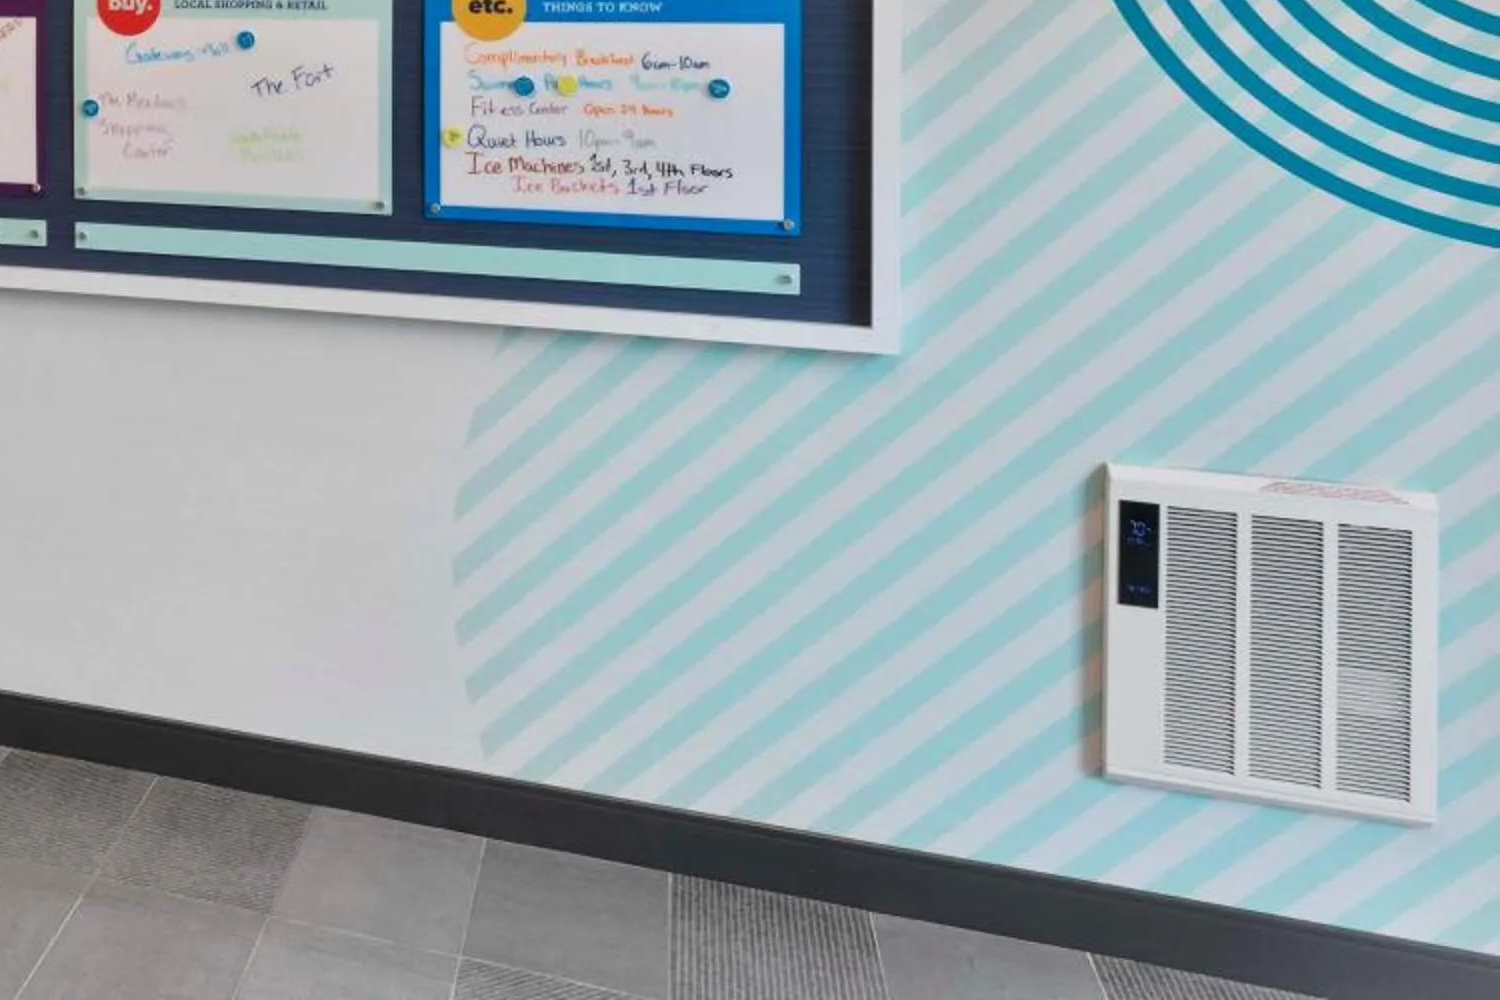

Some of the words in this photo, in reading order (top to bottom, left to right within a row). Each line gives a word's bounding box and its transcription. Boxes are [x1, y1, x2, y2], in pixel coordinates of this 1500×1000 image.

[173, 0, 212, 10] LOCAL
[214, 0, 274, 10] SHOPPING
[275, 0, 284, 10] &
[286, 0, 328, 11] RETAIL
[542, 1, 594, 13] THINGS
[596, 1, 616, 13] TO
[618, 1, 664, 13] KNOW
[465, 151, 502, 176] Ice
